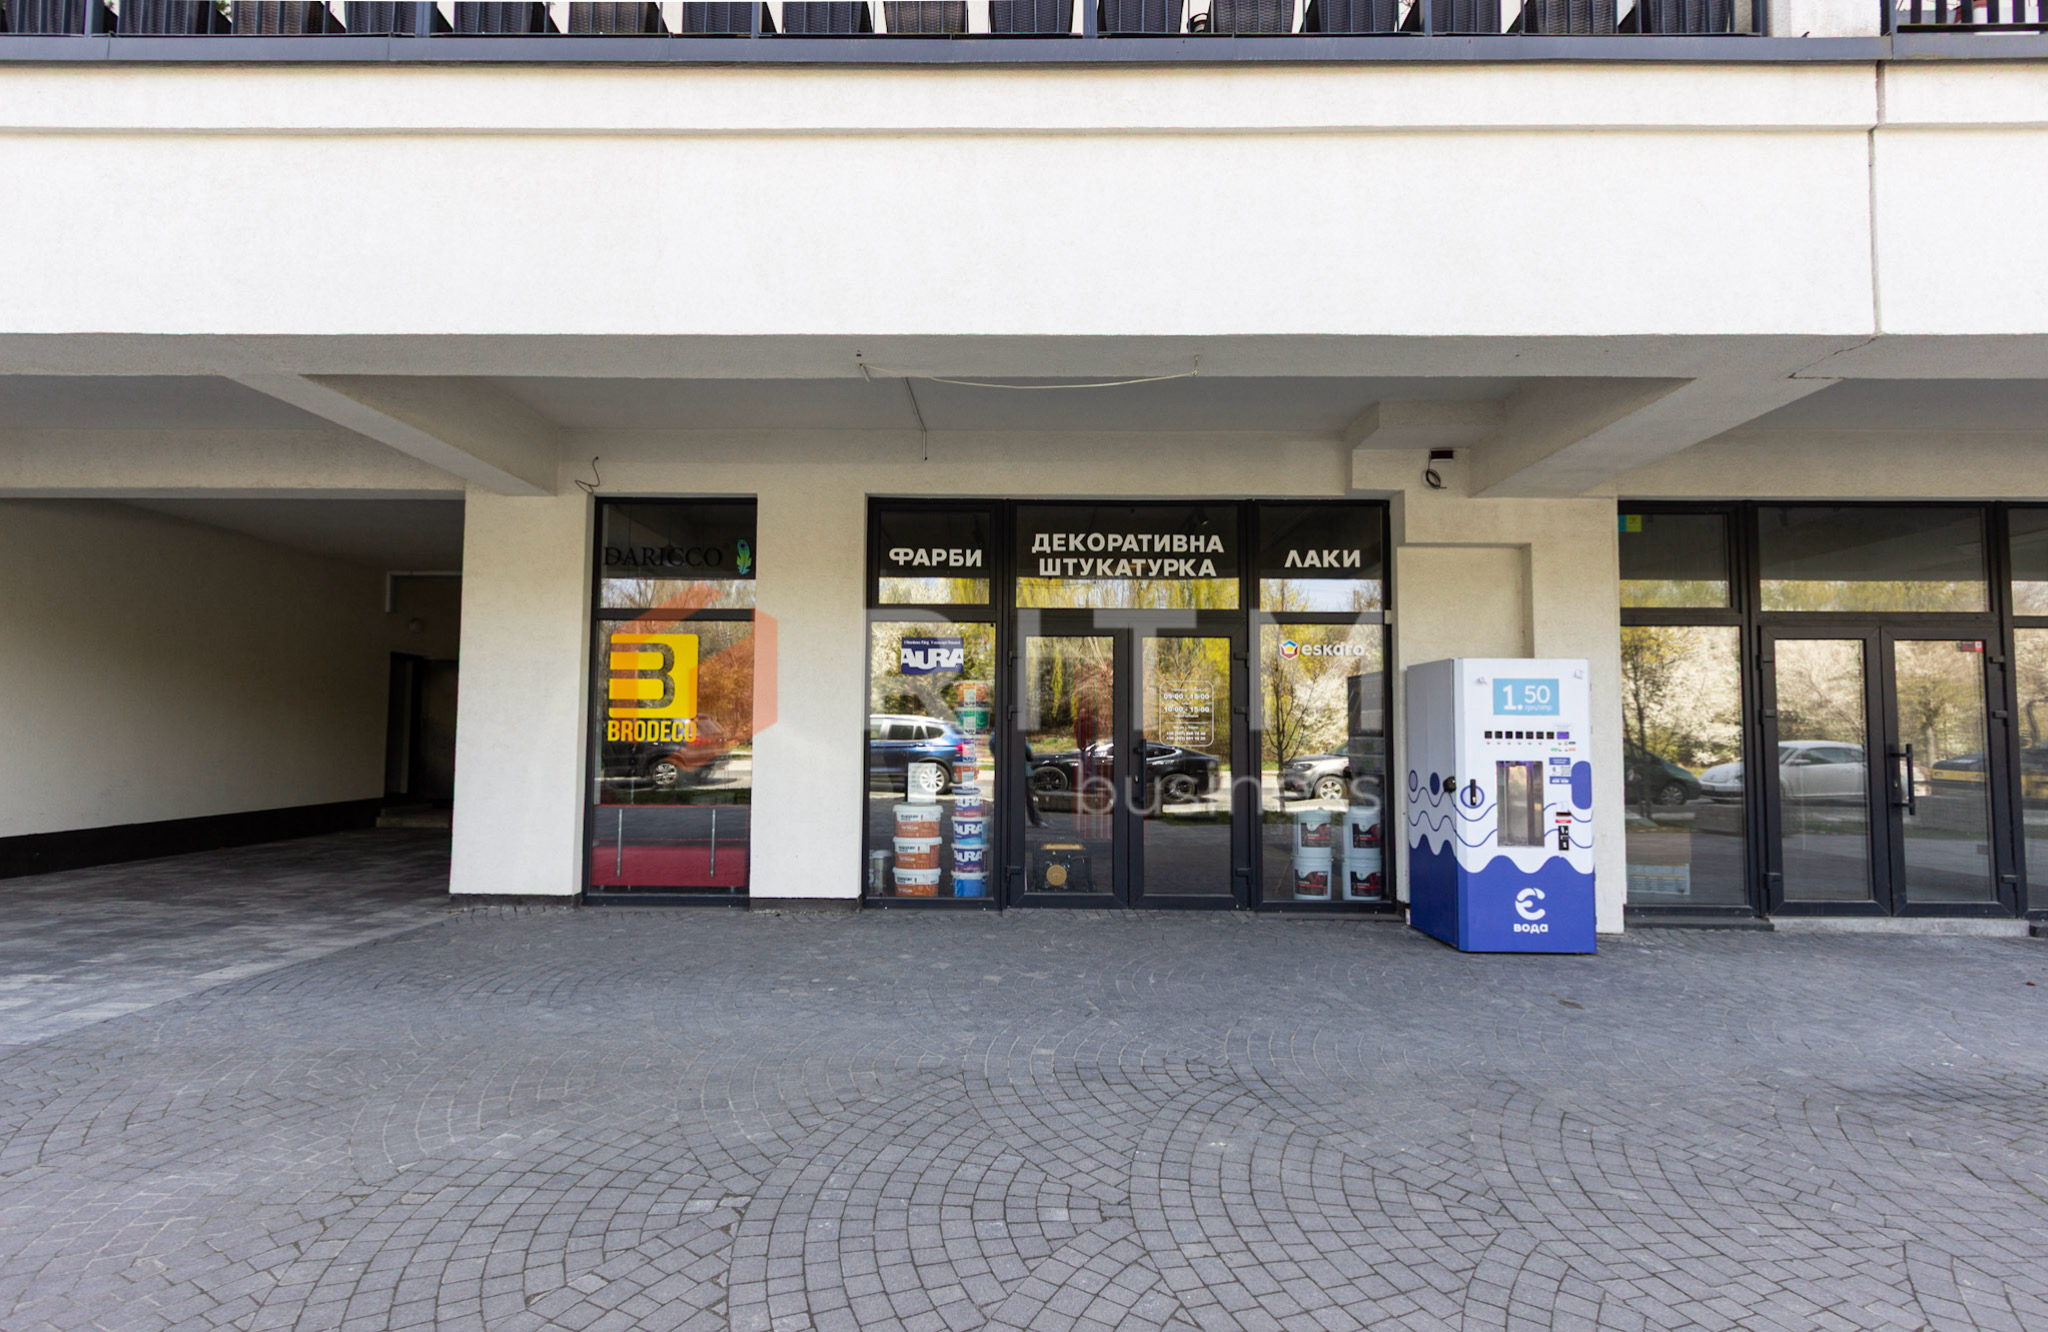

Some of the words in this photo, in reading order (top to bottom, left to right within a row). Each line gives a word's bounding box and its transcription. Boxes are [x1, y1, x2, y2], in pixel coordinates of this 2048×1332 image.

[1031, 532, 1224, 554] ДЕКОРАТИВНА
[603, 546, 723, 567] DARICCO
[889, 547, 983, 567] ФАРБИ
[1284, 549, 1361, 568] ЛАКИ
[1039, 557, 1217, 577] ШТУКАТУРКА
[901, 648, 964, 670] AURA
[1301, 643, 1365, 656] eskaro
[607, 720, 698, 742] BRODECO
[954, 823, 983, 835] AURA
[954, 850, 983, 862] AURA
[1513, 923, 1549, 934] вода
